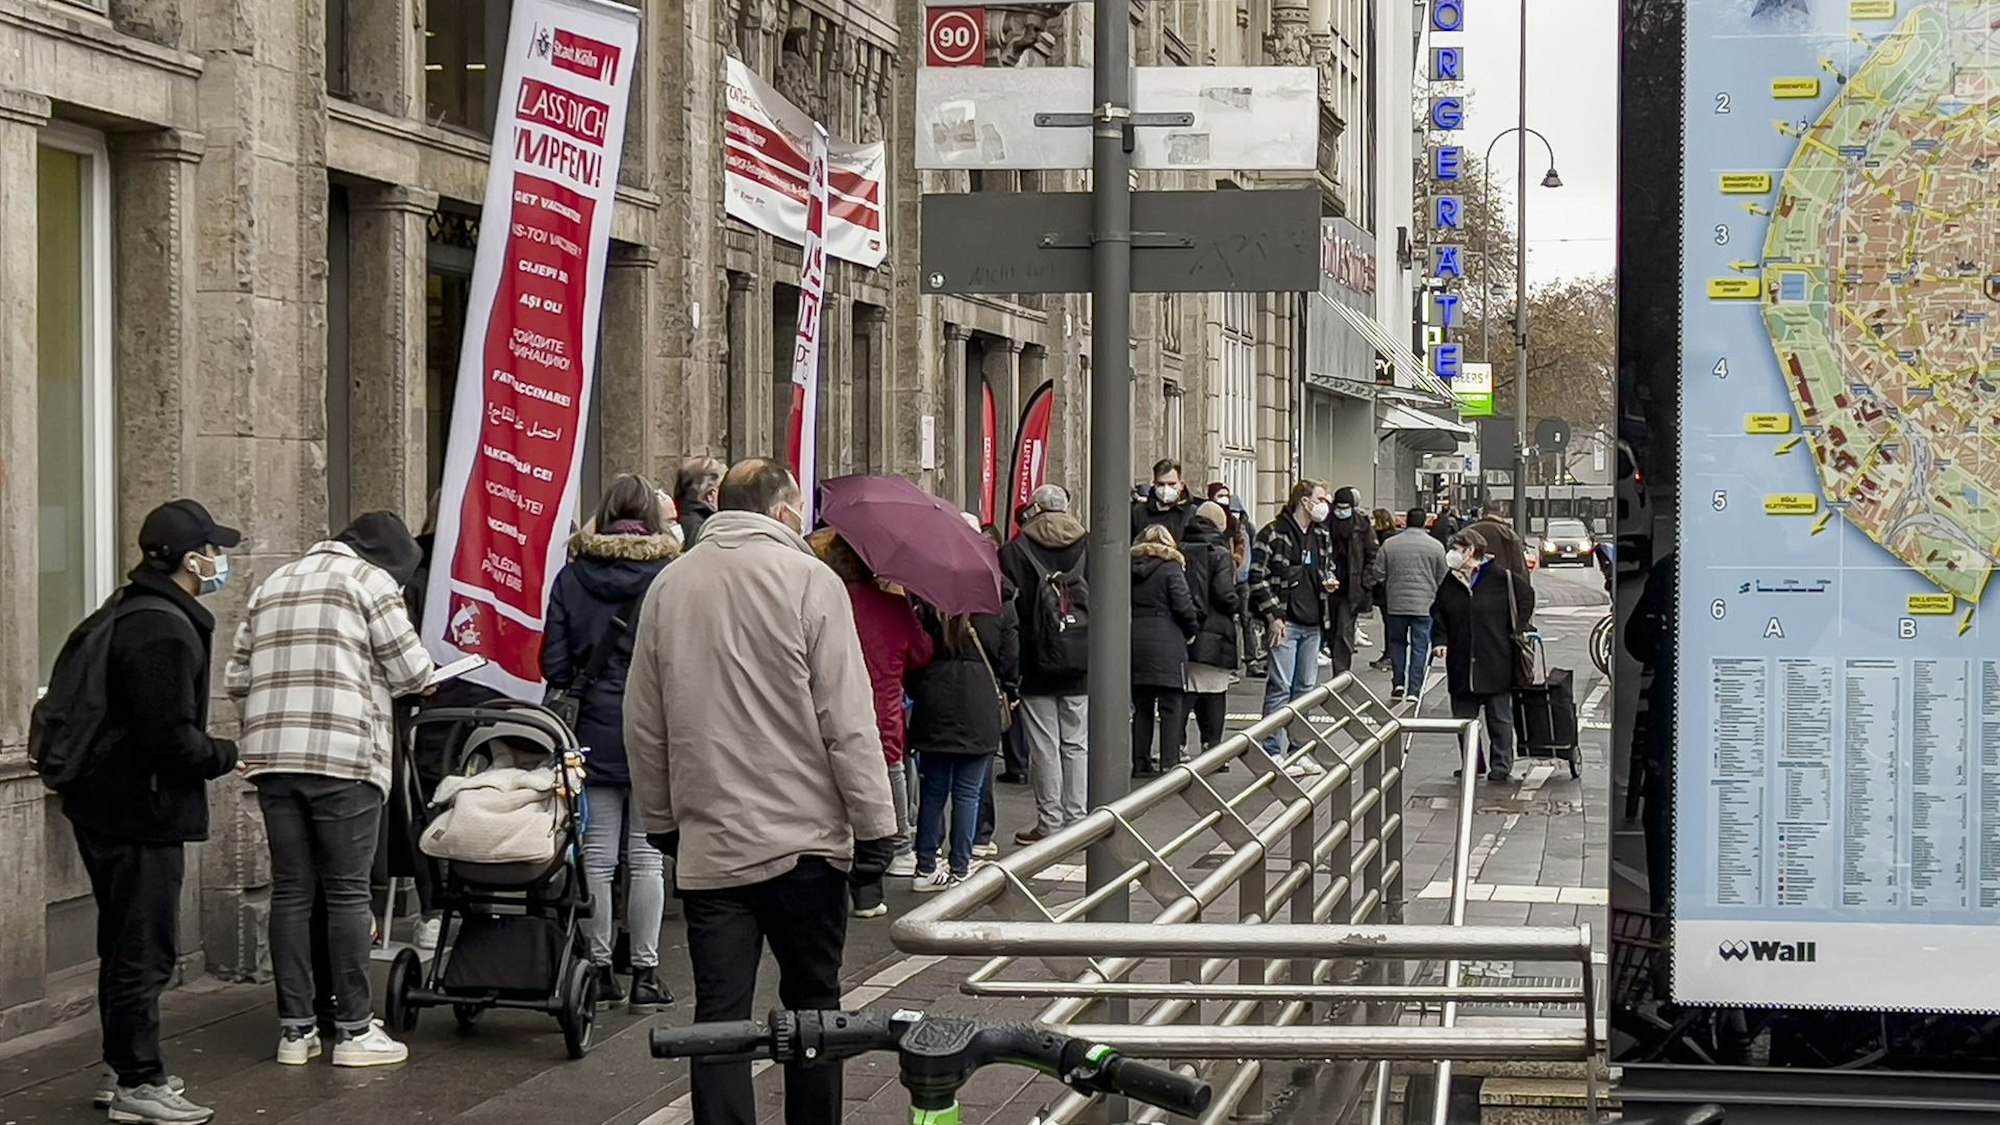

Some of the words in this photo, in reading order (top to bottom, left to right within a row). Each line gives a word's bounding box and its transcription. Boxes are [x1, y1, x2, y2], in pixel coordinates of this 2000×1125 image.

[938, 26, 970, 48] 90
[575, 46, 599, 69] Köln
[517, 84, 566, 125] LASS
[565, 98, 607, 139] DICH
[1715, 92, 1731, 114] 2
[514, 190, 539, 206] GET
[1715, 224, 1730, 246] 3
[1712, 357, 1728, 380] 4
[1711, 490, 1727, 512] 5
[1710, 598, 1726, 620] 6
[1763, 617, 1785, 639] A
[1898, 617, 1918, 639] B
[1751, 941, 1816, 962] Wall
